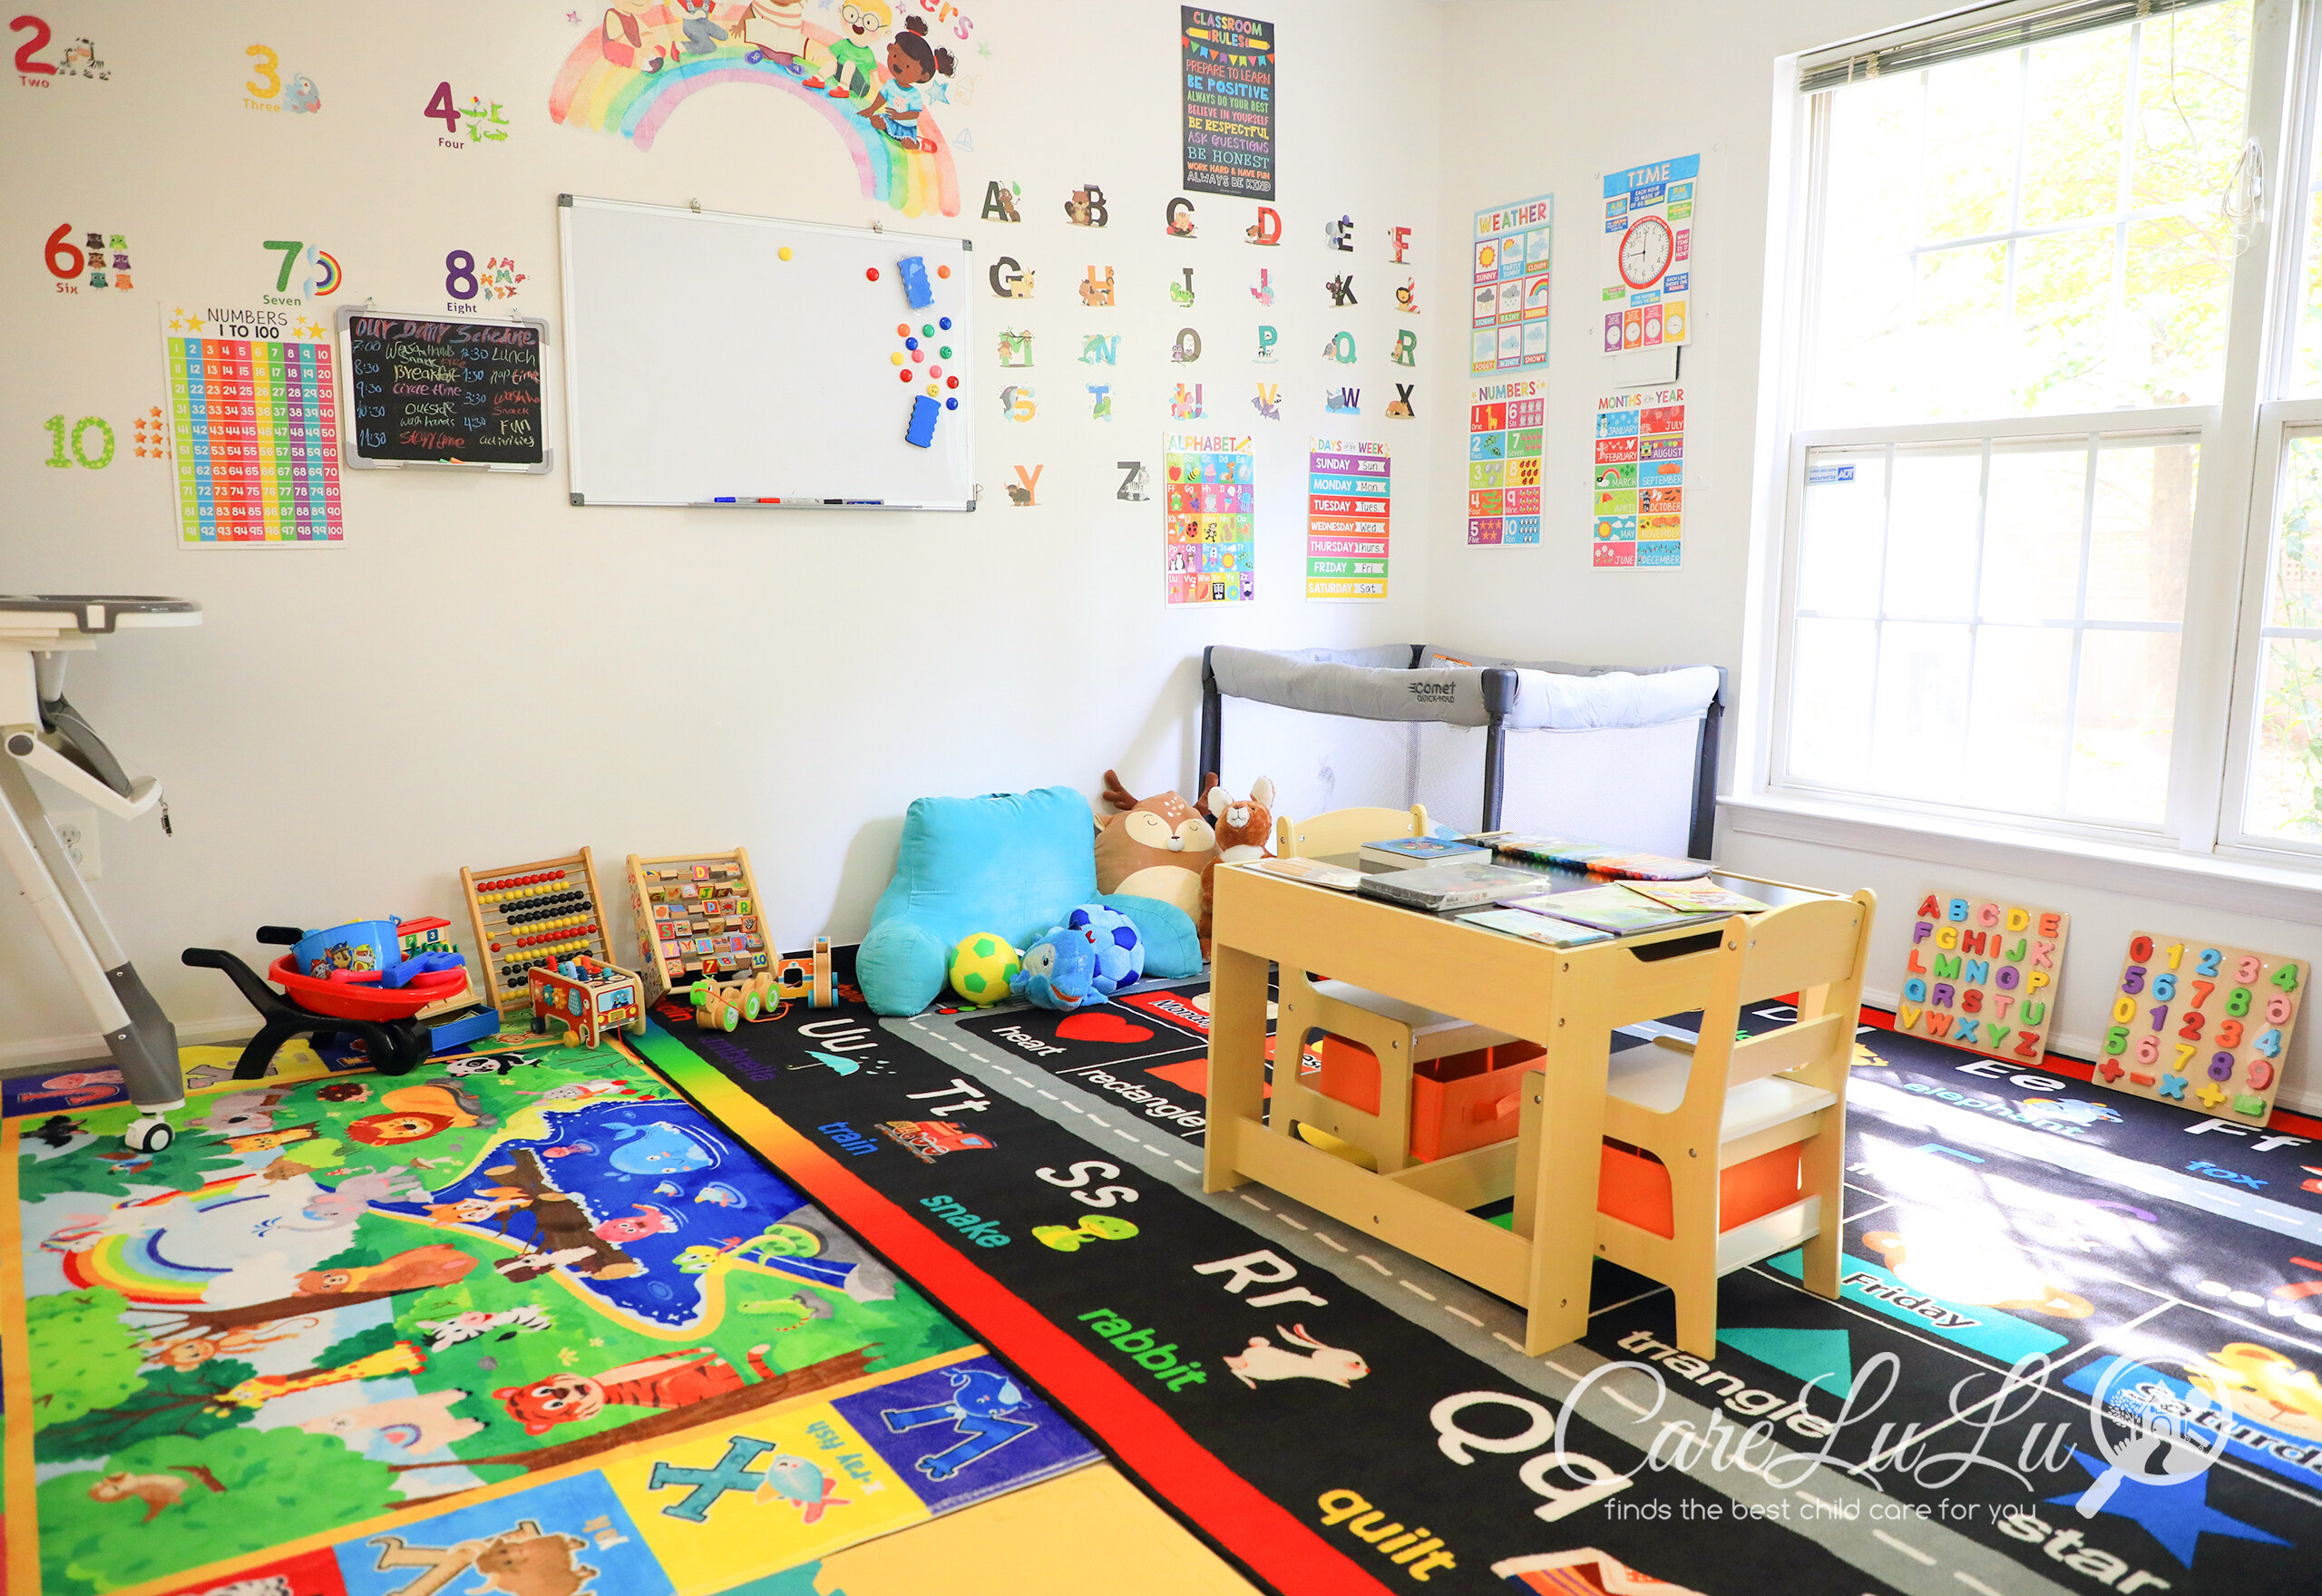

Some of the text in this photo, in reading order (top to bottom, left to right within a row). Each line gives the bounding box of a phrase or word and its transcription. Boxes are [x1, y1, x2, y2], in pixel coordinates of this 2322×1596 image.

[1193, 11, 1263, 36] CLASSROOM
[9, 15, 58, 75] 2
[1212, 30, 1244, 47] RULES
[19, 75, 50, 89] Two
[245, 44, 282, 100] 3
[1185, 59, 1270, 84] PREPARE TO LEARN
[1187, 74, 1269, 100] BE POSITIVE
[242, 98, 281, 113] Three
[424, 82, 461, 132] 4
[1187, 91, 1269, 112] ALWAYS DO YOUR BEST
[1188, 104, 1269, 125] BELIEVE IN YOURSELF
[1188, 116, 1269, 139] BE RESPECTFUL
[437, 137, 464, 151] Four
[1188, 131, 1269, 153] ASK QUESTIONS
[1188, 147, 1269, 169] BE HONEST
[1187, 162, 1207, 171] WORK
[1210, 164, 1229, 174] HARD
[1238, 169, 1254, 178] HAVE
[1187, 170, 1271, 191] ALWAYS BE KIND
[1628, 163, 1671, 189] TIME
[981, 180, 1009, 221] A
[1084, 185, 1108, 228] B
[1166, 197, 1195, 236] C
[1257, 207, 1282, 245] D
[1479, 202, 1546, 234] WEATHER
[1337, 220, 1353, 251] E
[44, 223, 85, 279] 6
[263, 240, 303, 292] 7
[444, 249, 479, 300] 8
[1476, 262, 1546, 282] SUNNY CLOUDY
[55, 282, 78, 295] Six
[263, 294, 301, 307] Seven
[446, 301, 477, 314] Eight
[208, 308, 288, 326] NUMBERS
[220, 326, 279, 338] 1 TO 100
[353, 340, 381, 353] 7:00
[354, 359, 379, 375] 8:30
[1475, 355, 1546, 370] FOGGY SNOWY
[463, 367, 484, 383] 1:30
[356, 381, 383, 398] 9:30
[462, 392, 486, 405] 3:30
[1479, 382, 1536, 401] NUMBERS
[1598, 389, 1683, 410] MONTHS YEAR
[464, 417, 485, 432] 4:30
[1607, 424, 1638, 436] JANUARY
[1665, 421, 1683, 430] JULY
[44, 414, 115, 470] 10
[359, 428, 386, 448] 11:30
[1168, 435, 1235, 452] ALPHABET
[1318, 439, 1383, 454] DAYS WEEK
[1605, 452, 1637, 462] FEBRUARY
[1654, 448, 1683, 458] AUGUST
[1316, 458, 1351, 470] SUNDAY
[1839, 470, 1853, 479] ADT
[1313, 479, 1352, 491] MONDAY
[1612, 478, 1636, 487] MARCH
[1643, 474, 1683, 486] SEPTEMBER
[1314, 500, 1351, 511] TUESDAY
[1614, 503, 1635, 513] APRIL
[1650, 502, 1682, 511] OCTOBER
[1311, 521, 1354, 531] WEDNESDAY
[1620, 530, 1635, 539] MAY
[1642, 528, 1681, 539] NOVEMBER
[1310, 540, 1353, 552] THURSDAY
[1314, 561, 1347, 573] FRIDAY
[1615, 556, 1634, 565] JUNE
[1642, 555, 1681, 565] DECEMBER
[1308, 582, 1352, 593] SATURDAY
[1917, 895, 2060, 938] A B C D E
[797, 1017, 878, 1054] Uu
[992, 1026, 1066, 1058] heart
[1955, 1059, 2067, 1092] Ee
[907, 1079, 992, 1117] Tt
[1078, 1065, 1206, 1129] rectangle
[1904, 1081, 2085, 1138] elephant
[817, 1121, 879, 1157] train
[2183, 1118, 2312, 1152] Ff
[1035, 1161, 1139, 1208] Ss
[2184, 1159, 2269, 1191] fox
[920, 1193, 1010, 1249] snake
[1193, 1249, 1329, 1308] Rr
[1840, 1271, 1982, 1331] Friday
[1077, 1308, 1207, 1392] rabbit
[1616, 1329, 1837, 1442] triangle
[805, 1420, 845, 1450] fish
[1429, 1390, 1634, 1522] Qq
[649, 1435, 778, 1523] X
[1317, 1488, 1457, 1581] quilt
[1996, 1516, 2171, 1594] star
